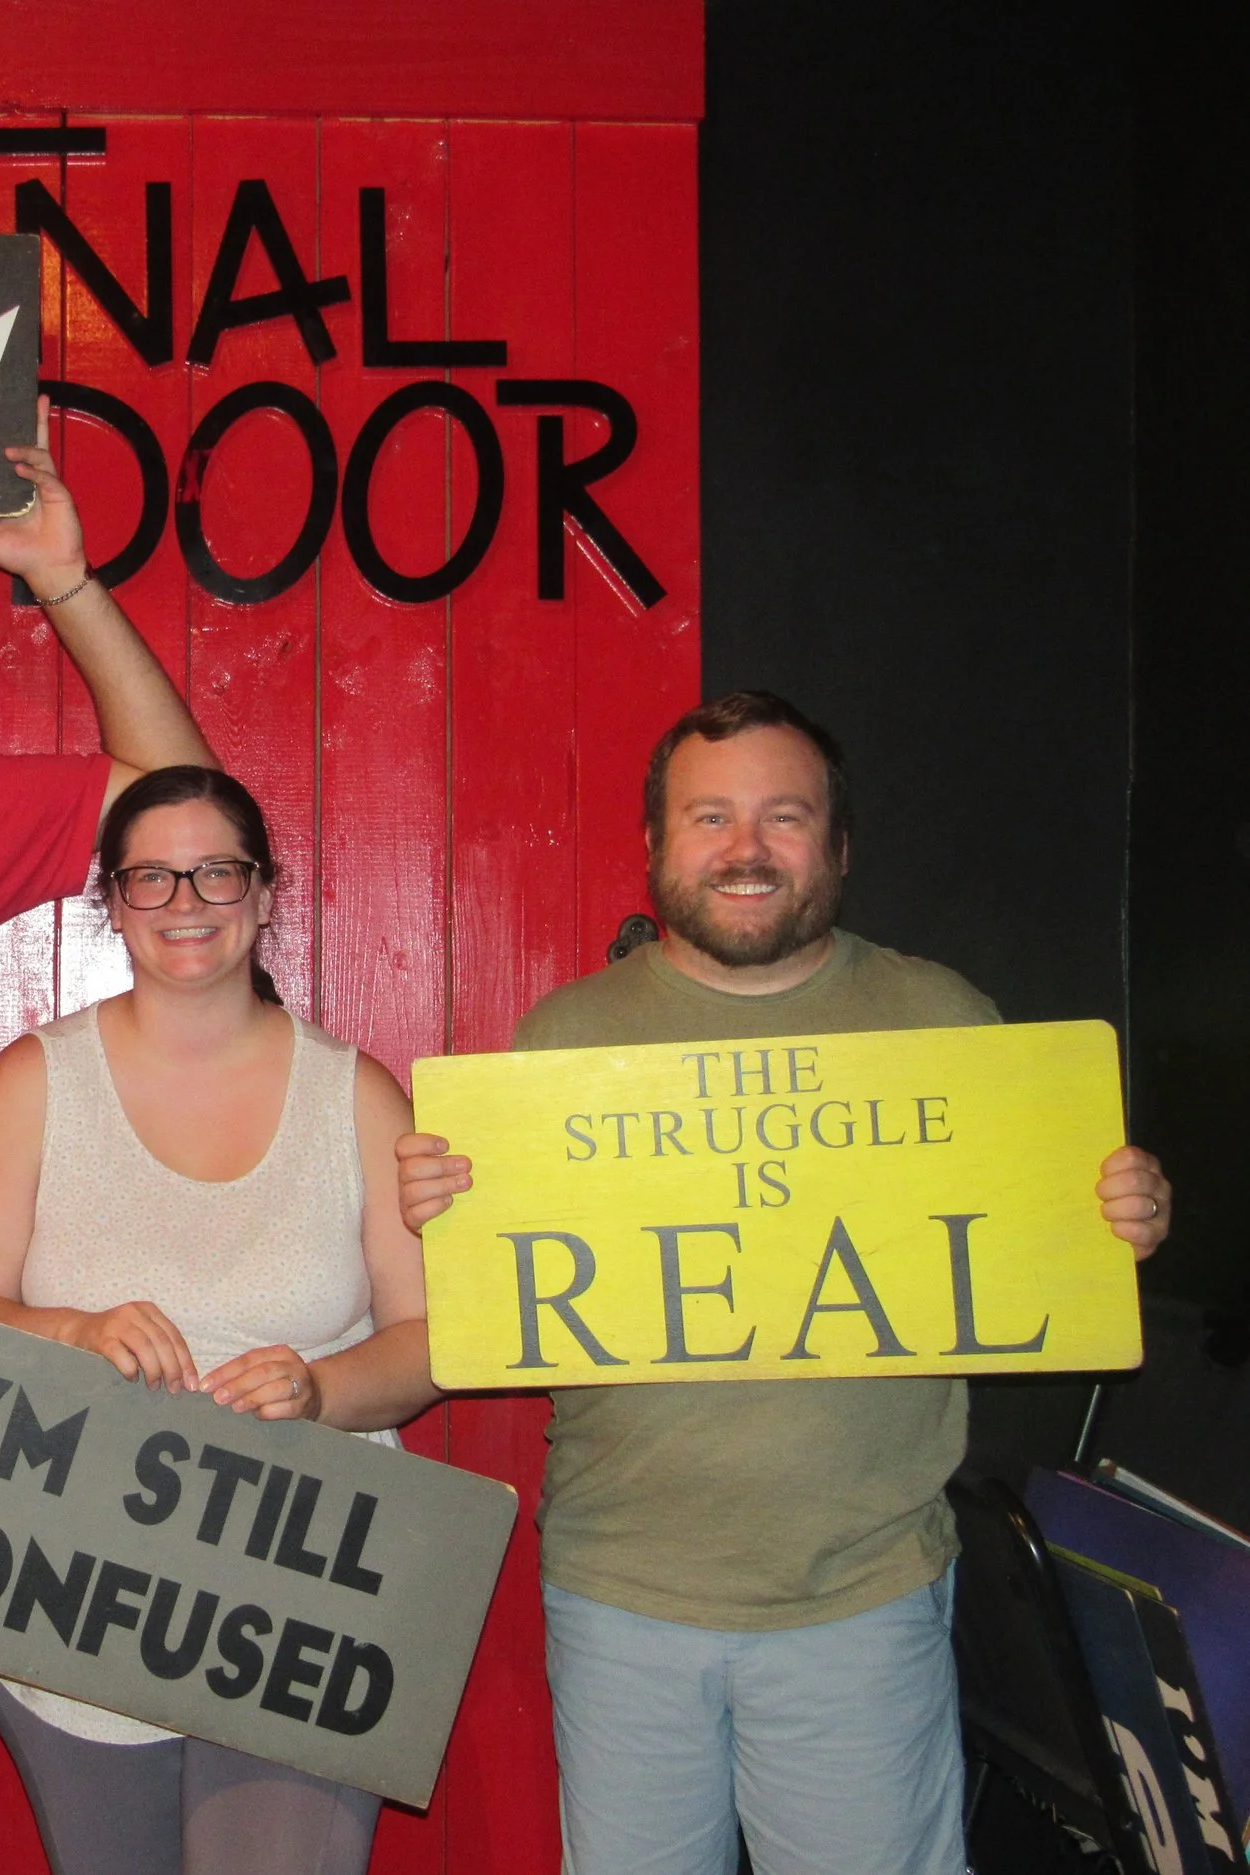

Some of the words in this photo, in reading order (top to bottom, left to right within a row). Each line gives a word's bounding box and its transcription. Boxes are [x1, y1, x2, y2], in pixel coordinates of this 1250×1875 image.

[681, 1046, 824, 1099] THE
[564, 1096, 954, 1163] STRUGGLE
[732, 1159, 793, 1209] IS
[496, 1212, 1051, 1370] REAL
[122, 1429, 384, 1597] STILL
